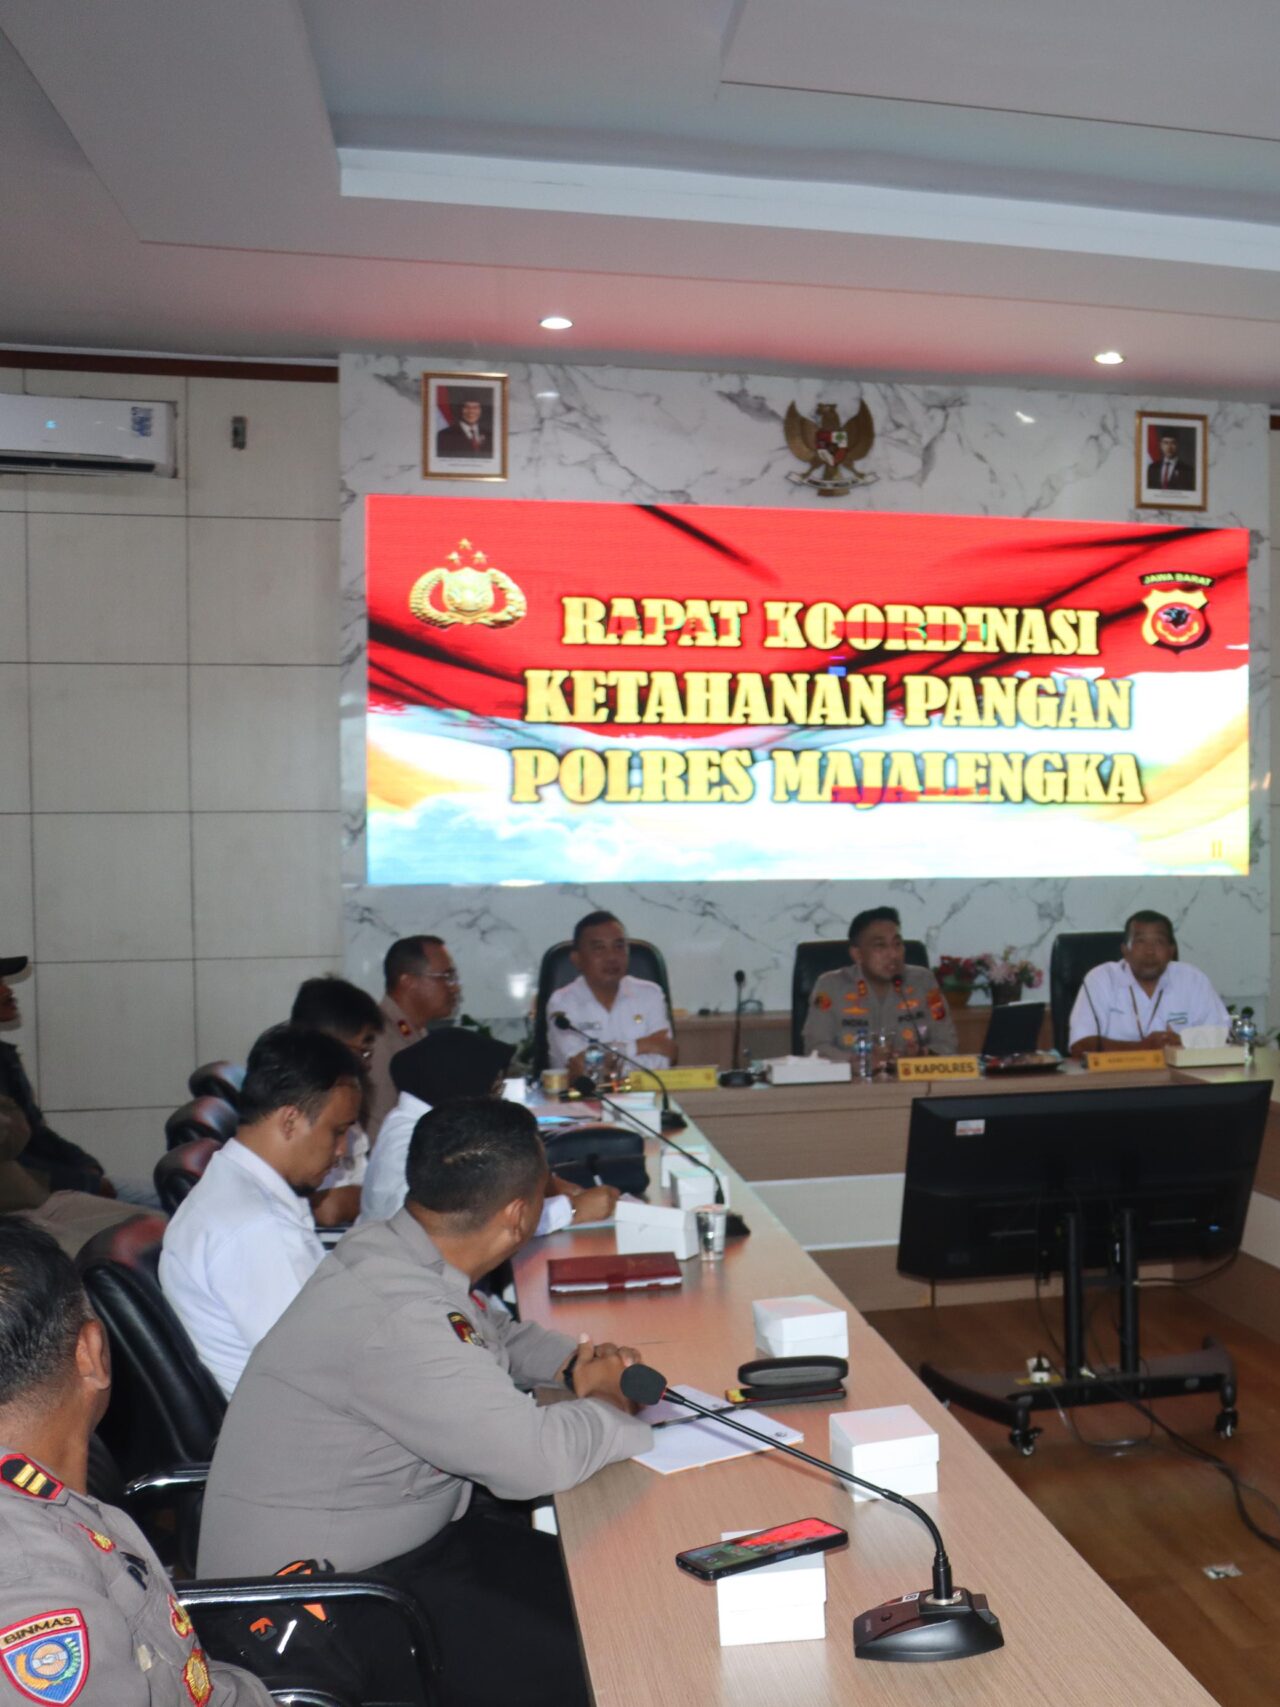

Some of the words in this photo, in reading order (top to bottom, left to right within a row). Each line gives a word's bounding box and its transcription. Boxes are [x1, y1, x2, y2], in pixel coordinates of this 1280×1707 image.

[1143, 573, 1175, 585] JAWA
[1174, 573, 1213, 586] BARAT
[561, 596, 748, 646] RAPAT
[763, 601, 1100, 655] KOORDINASI
[524, 669, 886, 726] KETAHANAN
[903, 675, 1133, 729] PANGAN
[511, 748, 754, 803] POLRES
[772, 750, 1145, 809] MAJALENGKA
[914, 1063, 976, 1075] KAPOLRES
[7, 1616, 74, 1645] BINMAS
